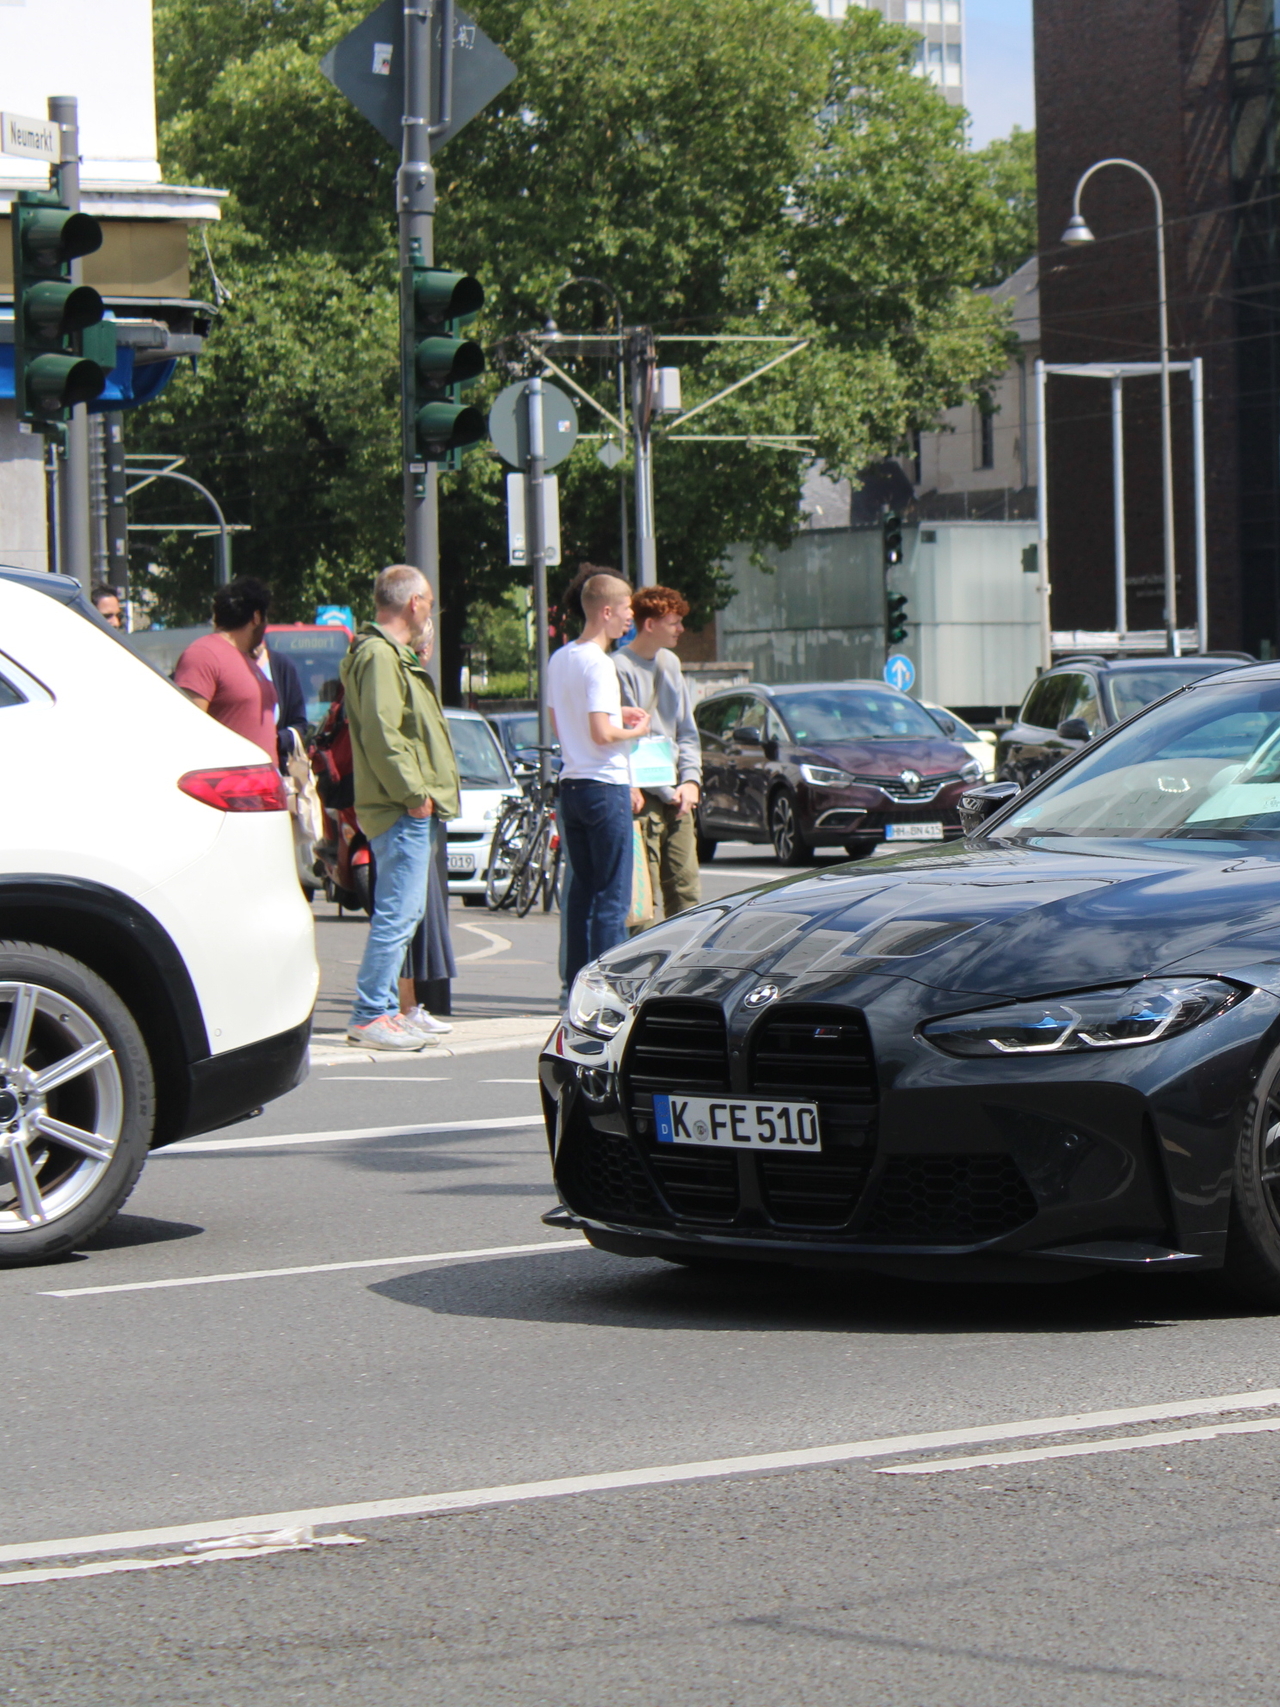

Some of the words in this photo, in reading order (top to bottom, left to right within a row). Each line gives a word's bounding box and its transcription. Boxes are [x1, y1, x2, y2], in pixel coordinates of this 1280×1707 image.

[10, 120, 53, 152] Neumarkt
[671, 1100, 692, 1138] K
[709, 1103, 751, 1142] FE
[756, 1106, 818, 1145] 510
